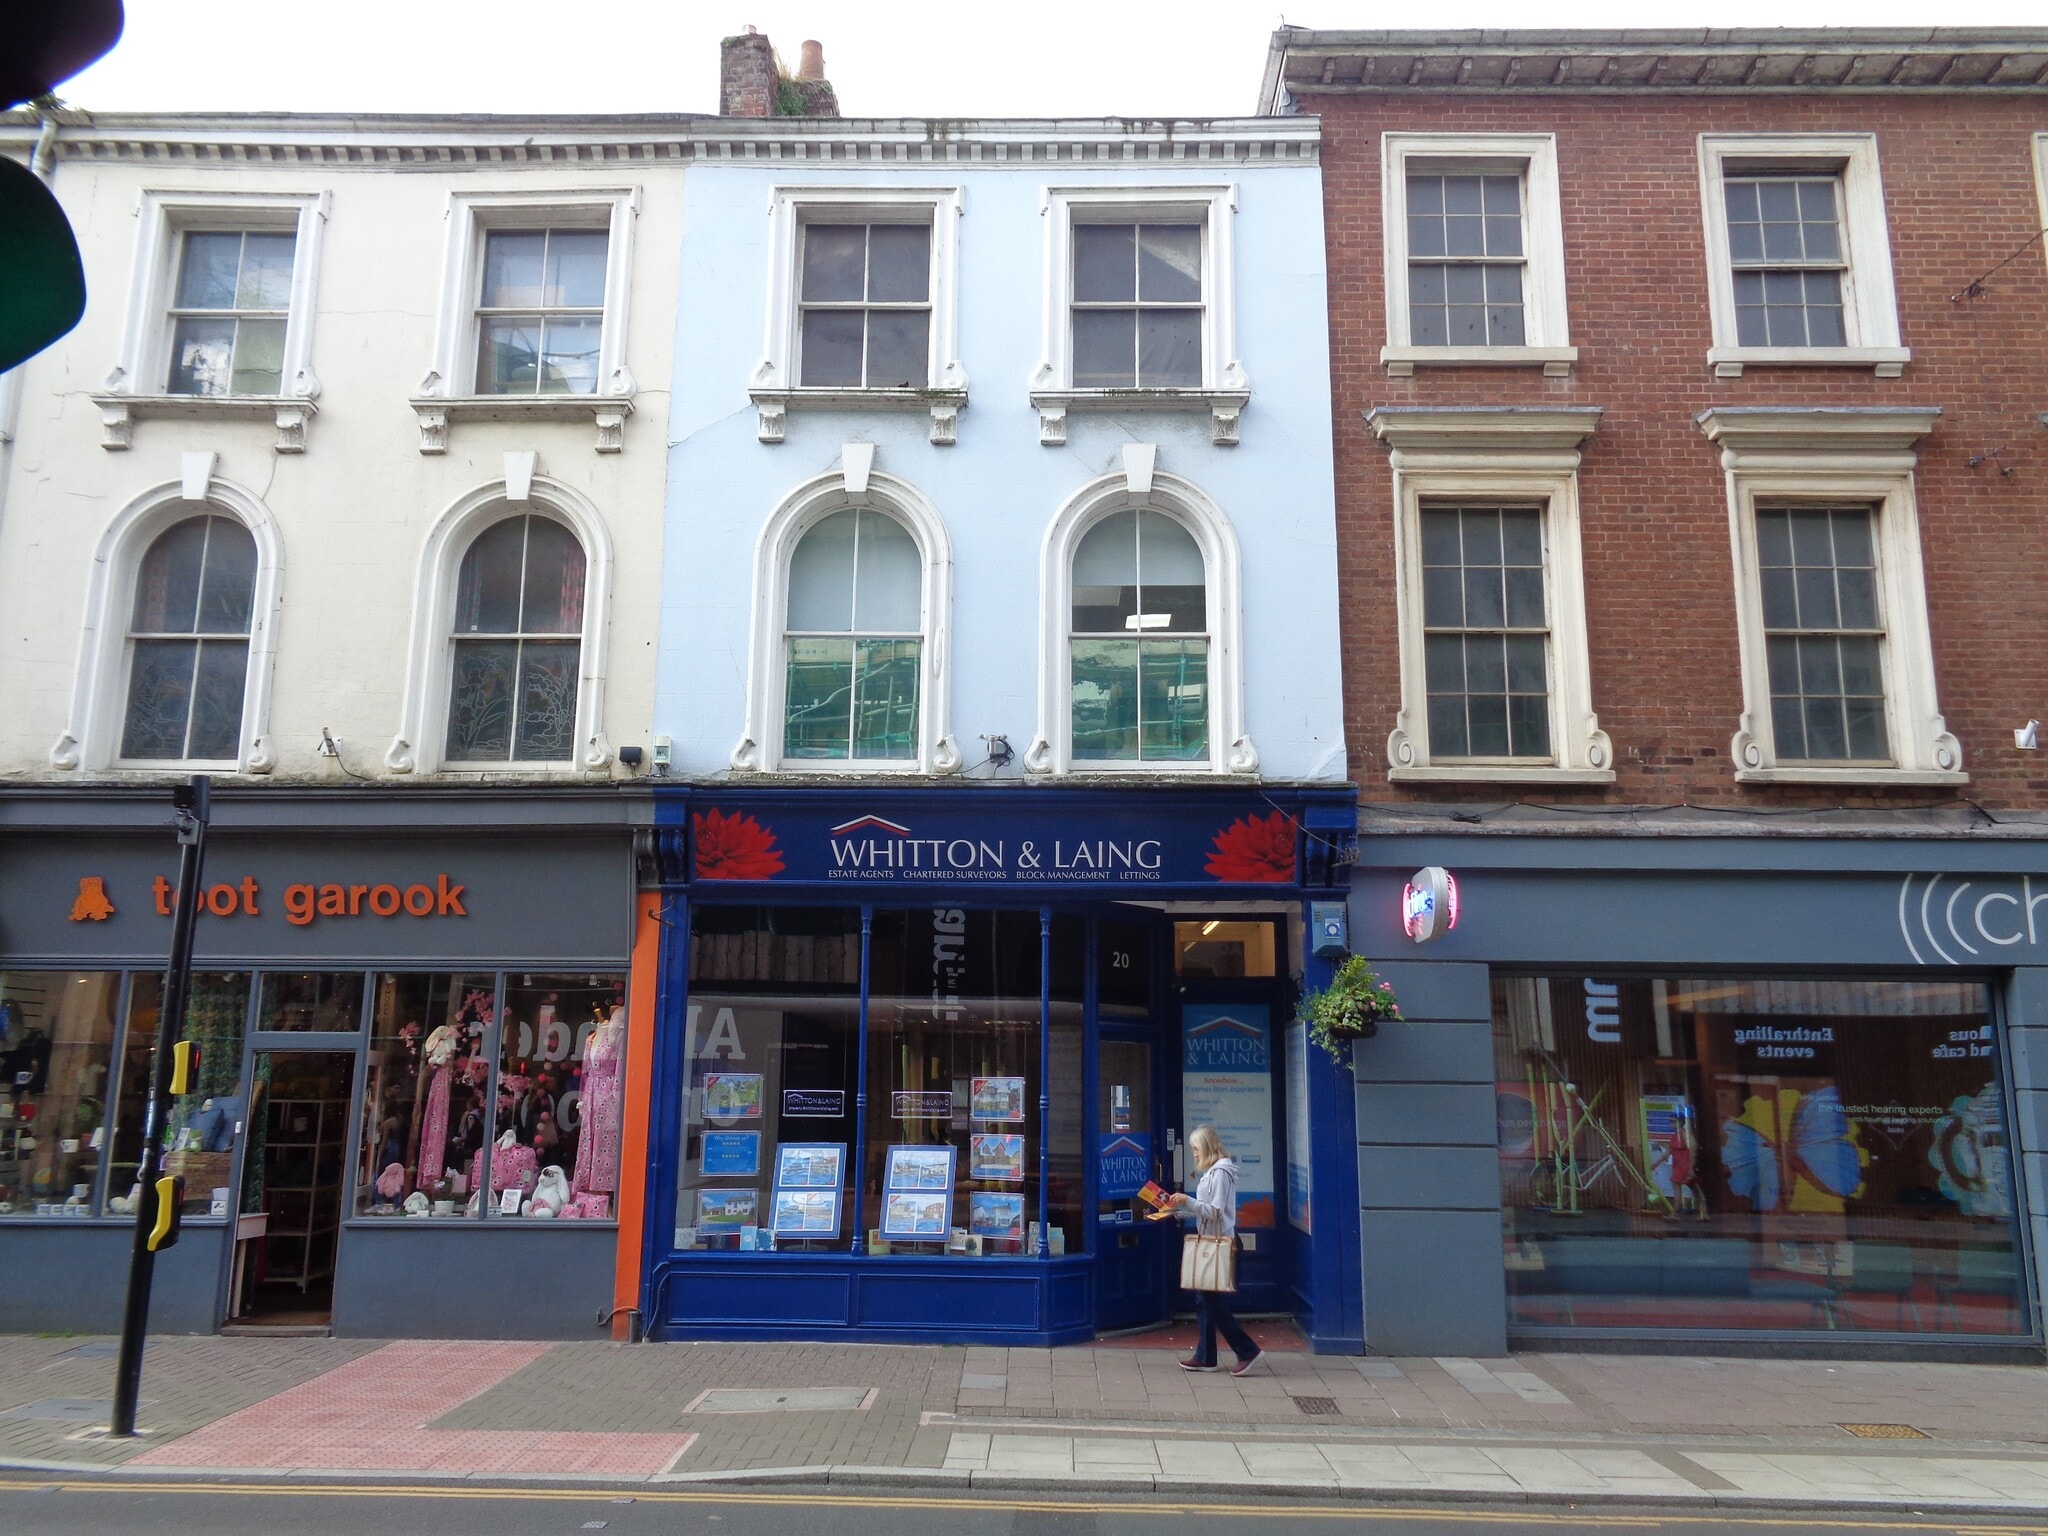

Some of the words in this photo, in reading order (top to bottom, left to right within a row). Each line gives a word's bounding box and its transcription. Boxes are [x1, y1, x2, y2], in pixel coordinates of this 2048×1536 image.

[831, 839, 1003, 868] WHITTON
[1017, 840, 1041, 868] &
[1055, 840, 1161, 869] LAING
[828, 869, 858, 878] ESTATE
[859, 869, 894, 878] AGENTS
[903, 870, 954, 879] CHARTERED
[956, 870, 1007, 879] SURVEYORS
[1016, 871, 1045, 879] BLOCK
[1047, 871, 1111, 880] MANAGEMENT
[1119, 871, 1160, 880] LETTINGS
[283, 874, 467, 925] garook
[1112, 951, 1129, 968] 20
[1186, 1038, 1265, 1051] WHITTON
[1187, 1052, 1199, 1065] &
[1208, 1052, 1265, 1065] LAING
[1818, 1103, 1833, 1113] the
[1835, 1103, 1868, 1113] trusted
[1870, 1104, 1906, 1115] hearing
[1908, 1105, 1943, 1115] experts
[1101, 1156, 1147, 1170] WHITTON
[1101, 1170, 1108, 1183] &
[1113, 1169, 1147, 1183] LAING
